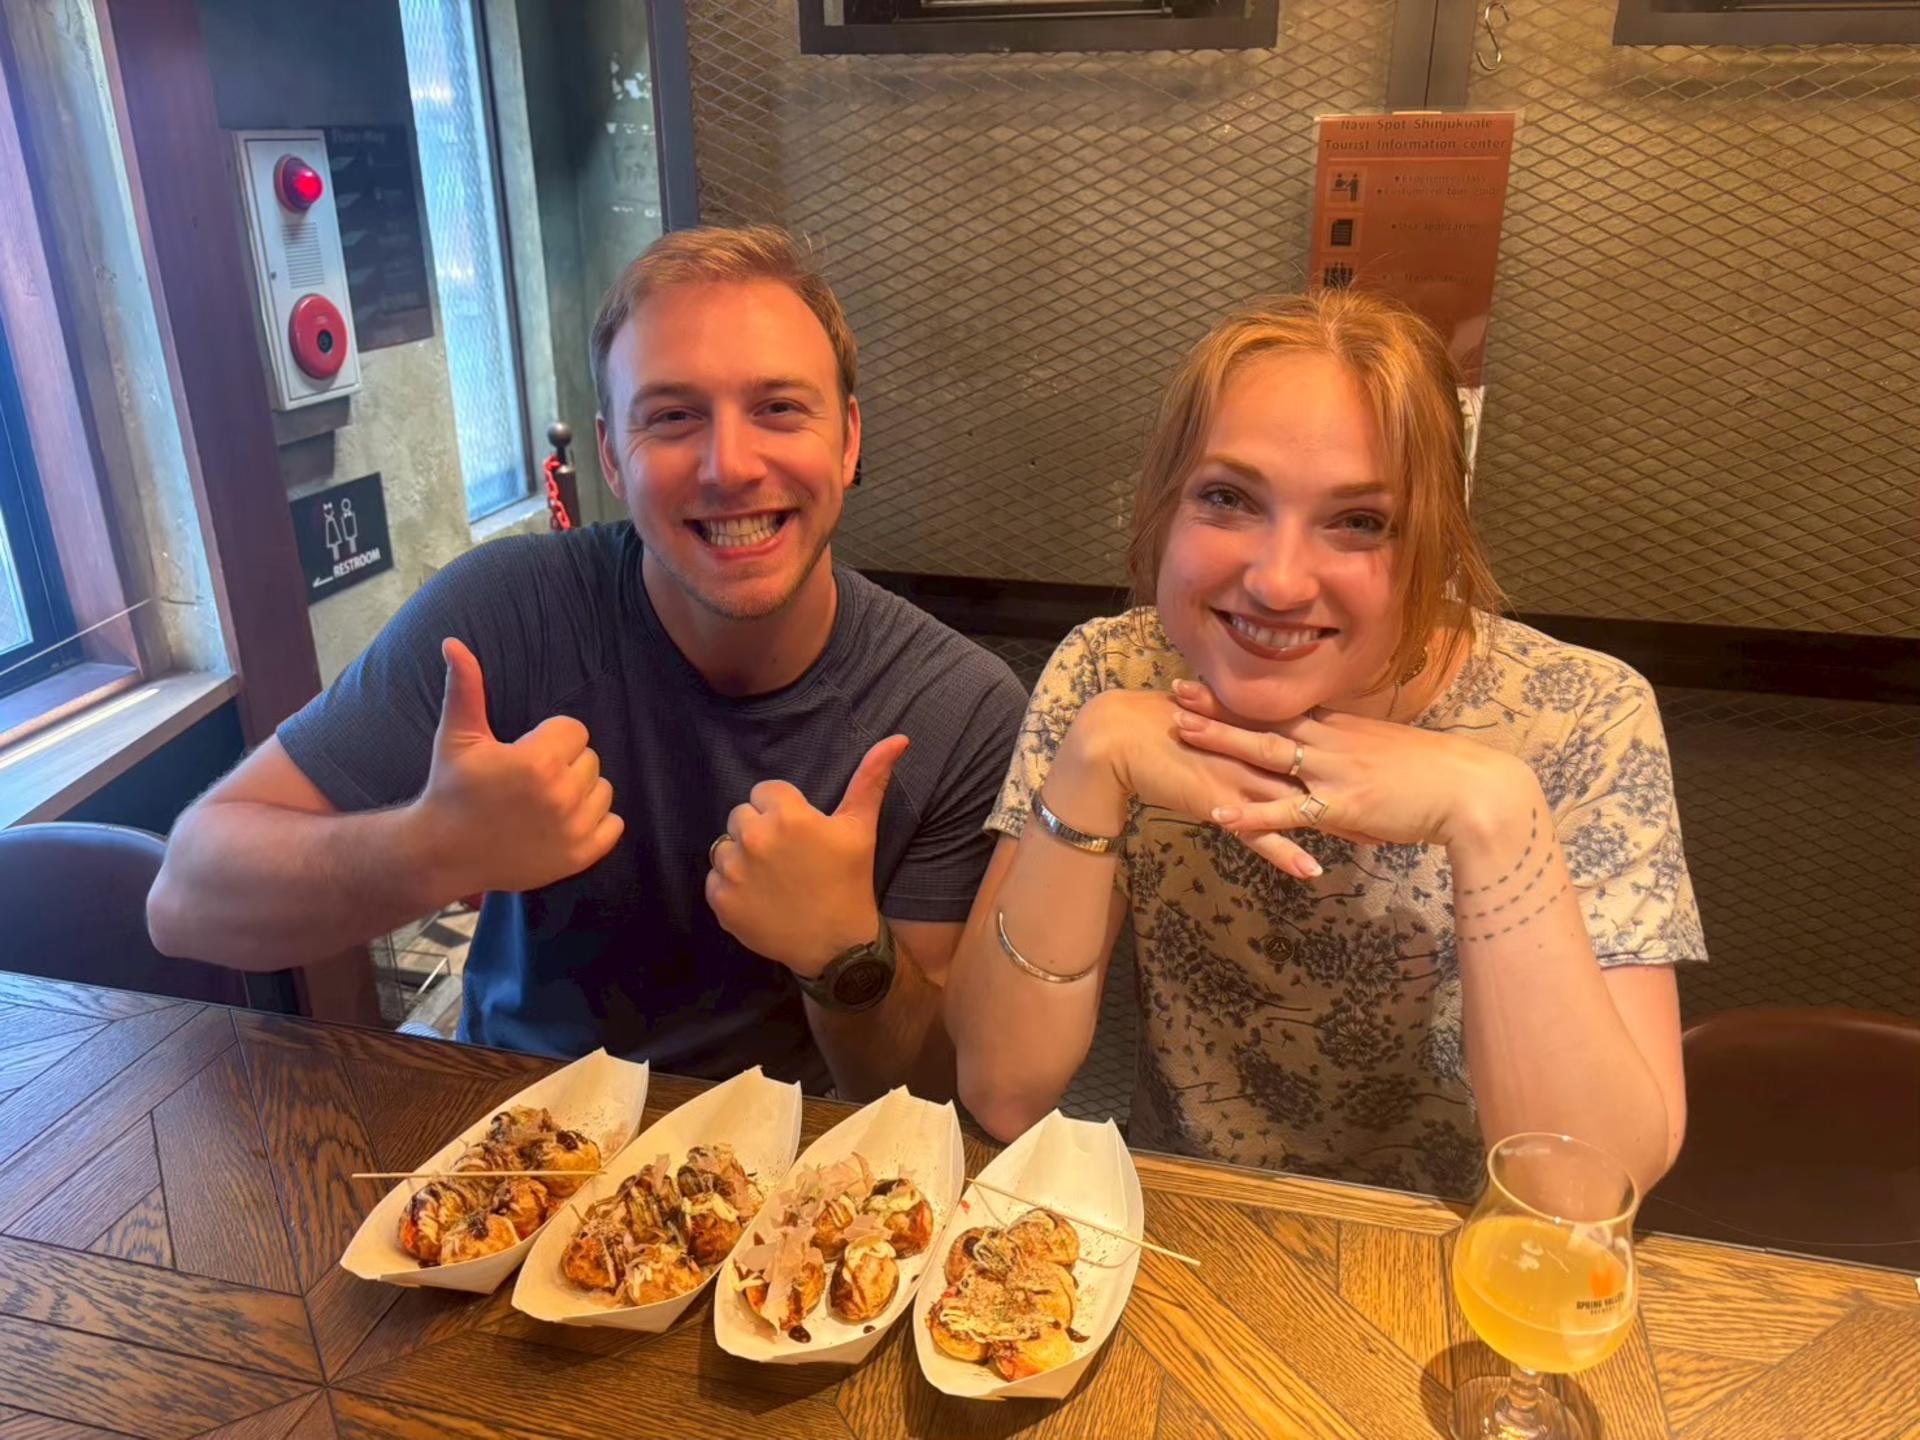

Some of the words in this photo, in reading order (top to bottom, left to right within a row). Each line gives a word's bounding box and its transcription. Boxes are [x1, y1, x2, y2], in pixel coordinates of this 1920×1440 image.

[1340, 120, 1369, 130] Navi
[1376, 119, 1406, 131] Spot
[1324, 139, 1370, 151] Tourist
[1376, 138, 1456, 150] Information
[1463, 138, 1507, 150] center
[333, 547, 381, 577] RESTROOM
